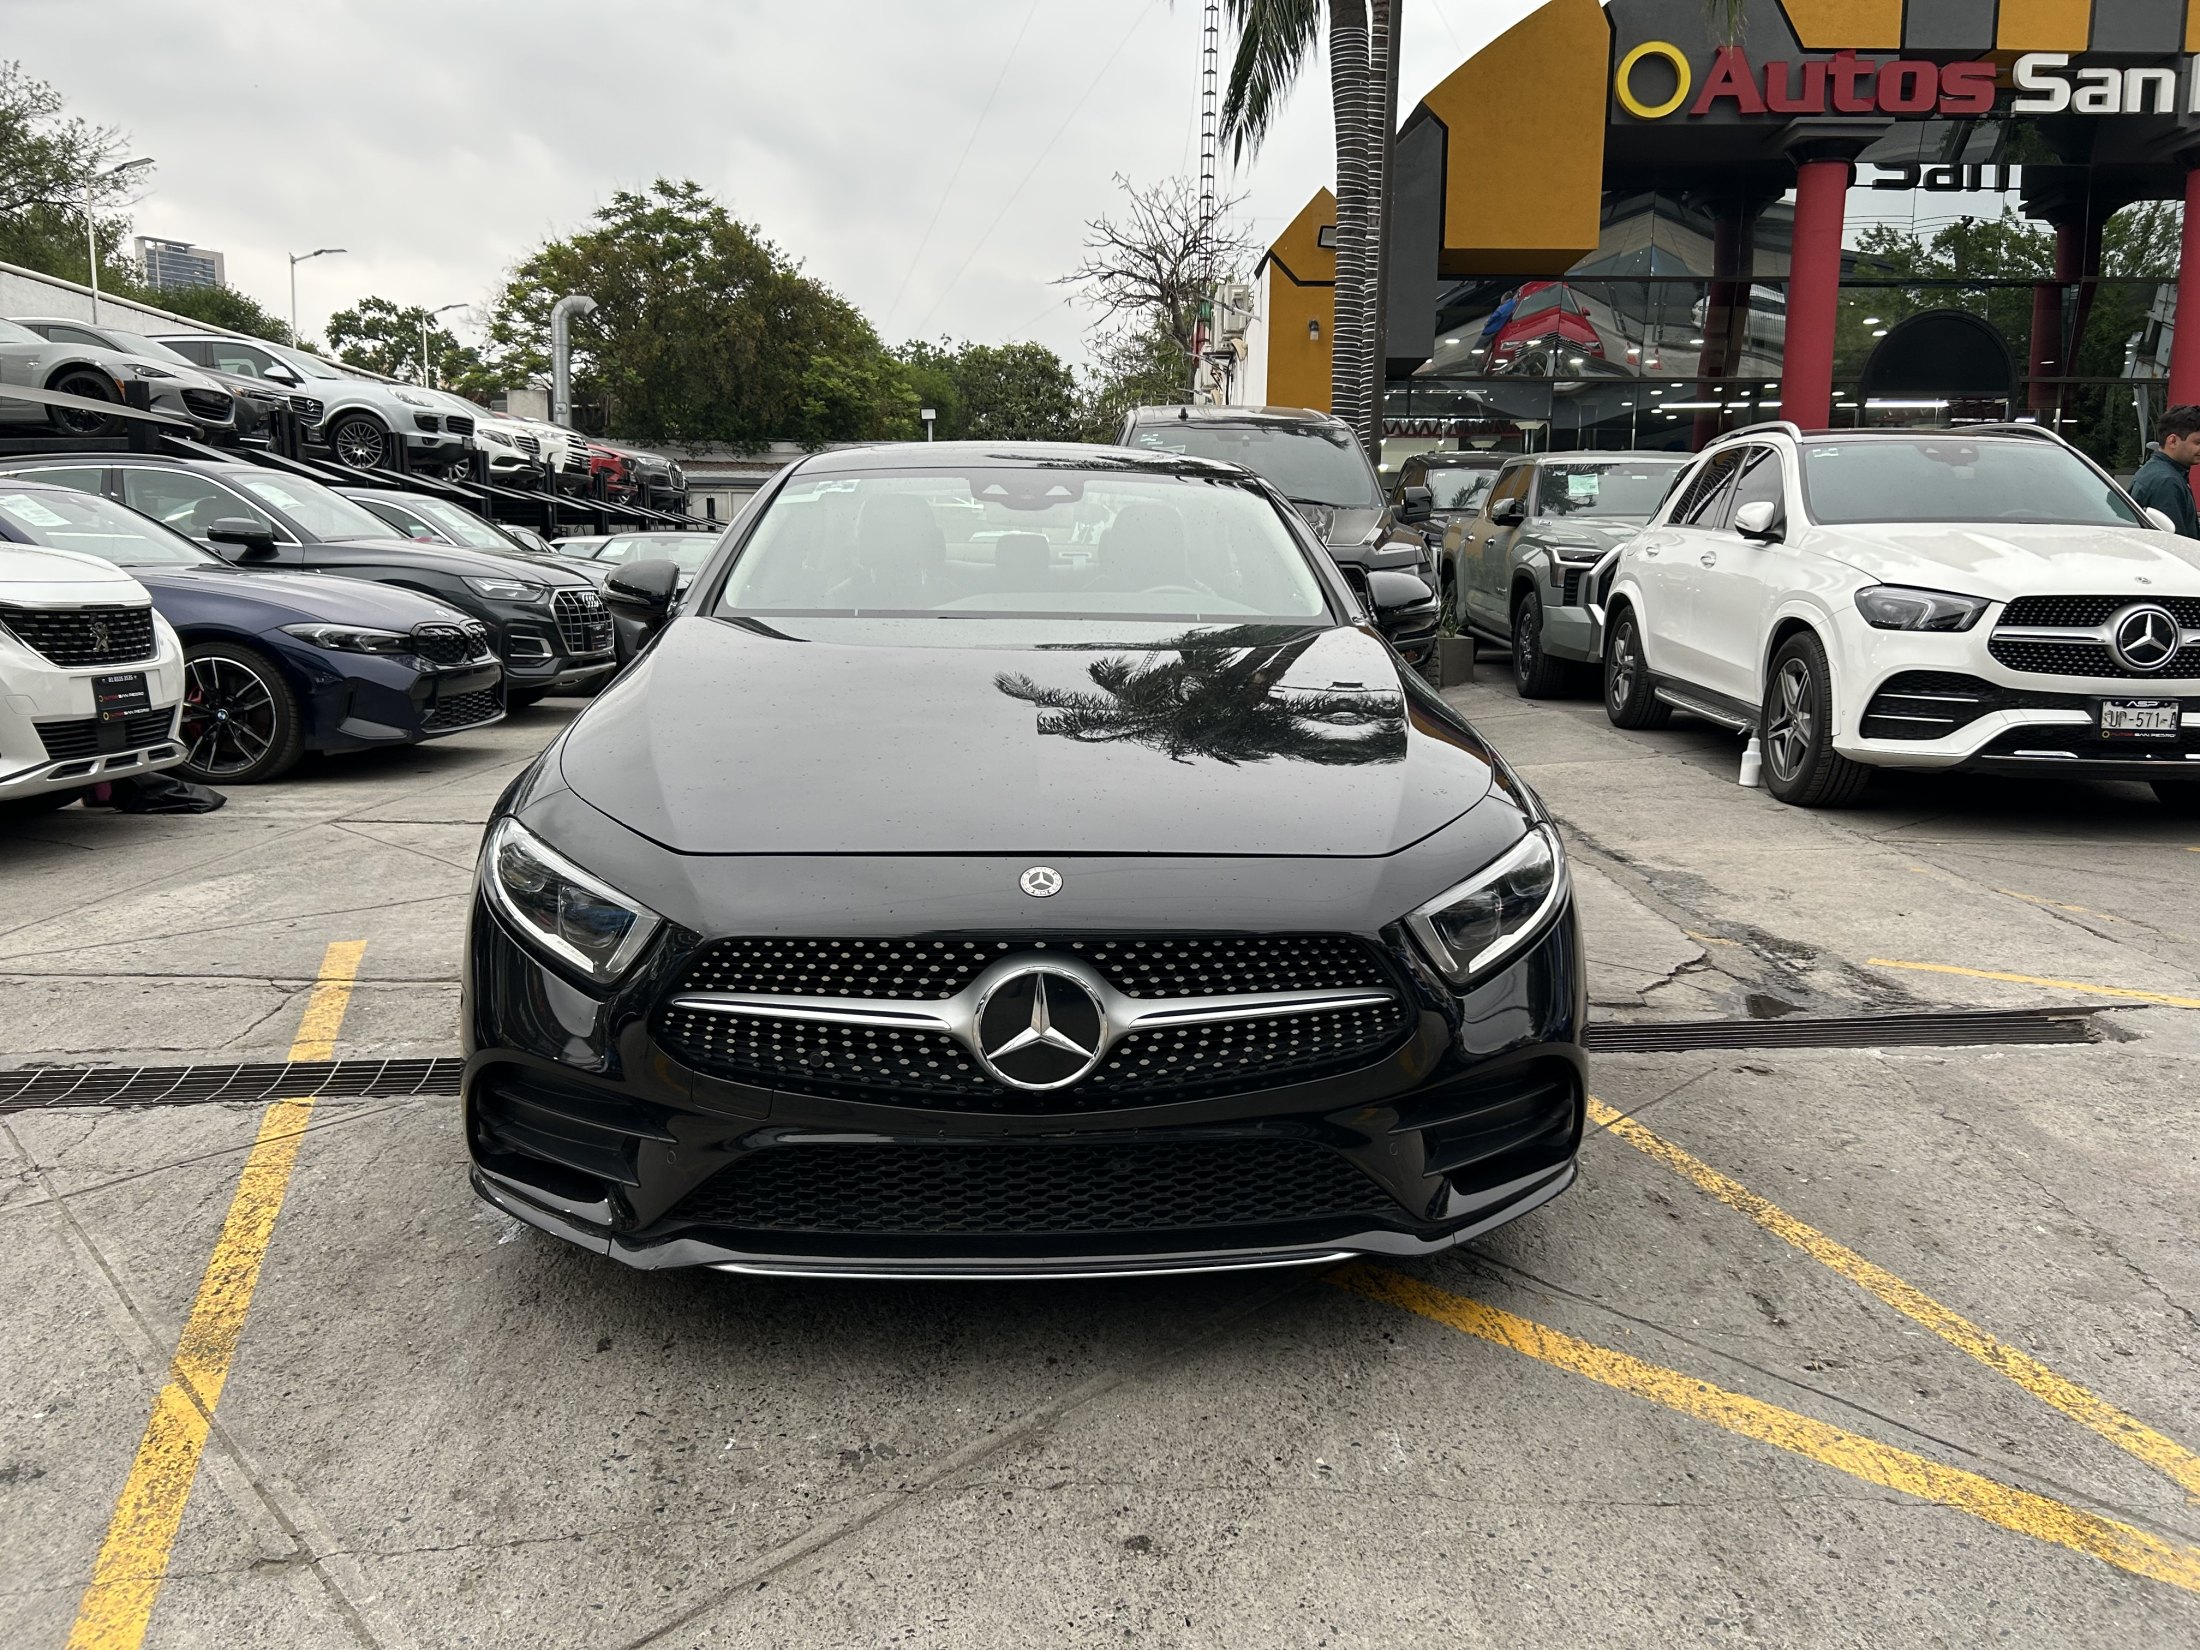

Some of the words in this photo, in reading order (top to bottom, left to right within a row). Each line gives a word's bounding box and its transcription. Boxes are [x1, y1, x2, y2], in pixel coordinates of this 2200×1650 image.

[1689, 45, 1998, 115] Autos
[2010, 53, 2176, 115] San
[2126, 700, 2160, 708] ASP
